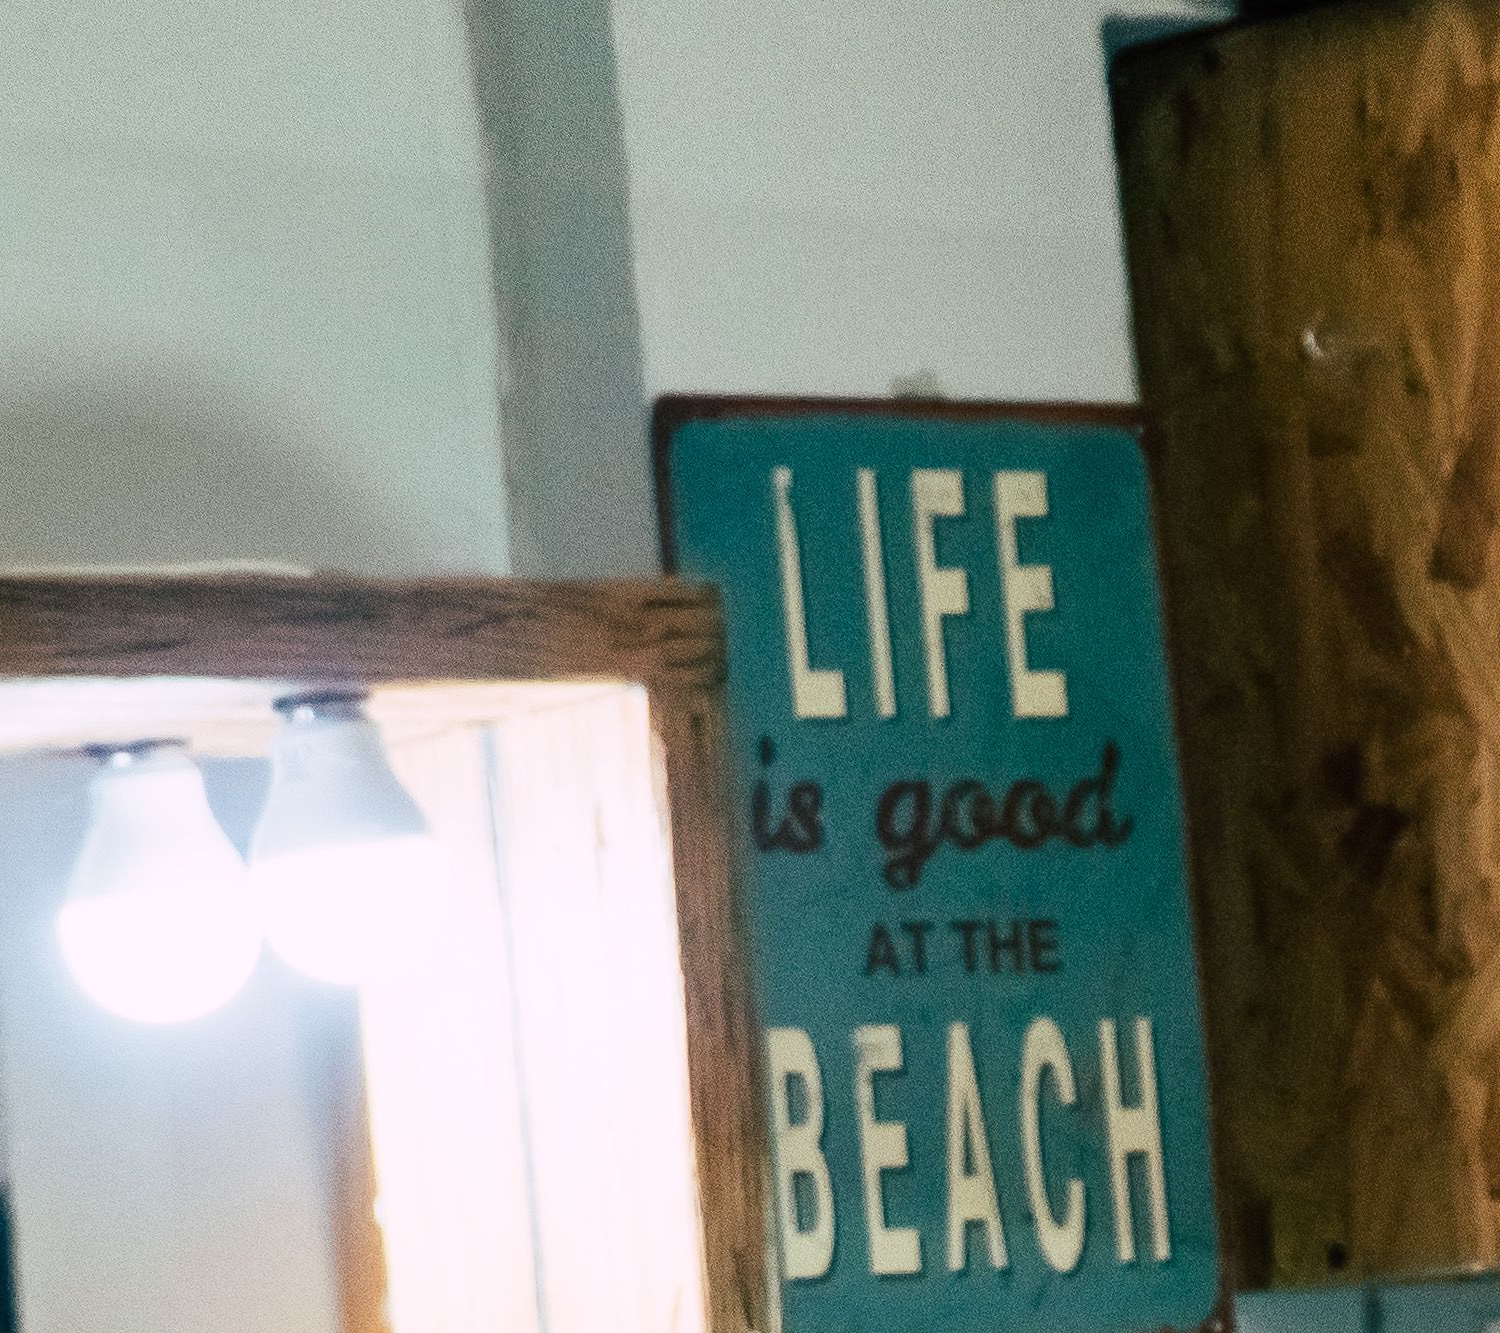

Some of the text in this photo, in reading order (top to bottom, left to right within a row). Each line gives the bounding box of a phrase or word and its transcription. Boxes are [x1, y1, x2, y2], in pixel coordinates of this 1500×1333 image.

[771, 466, 1069, 719] LIFE
[753, 735, 1135, 890] is good
[863, 917, 1062, 978] AT THE
[767, 1016, 1170, 1281] BEACH
